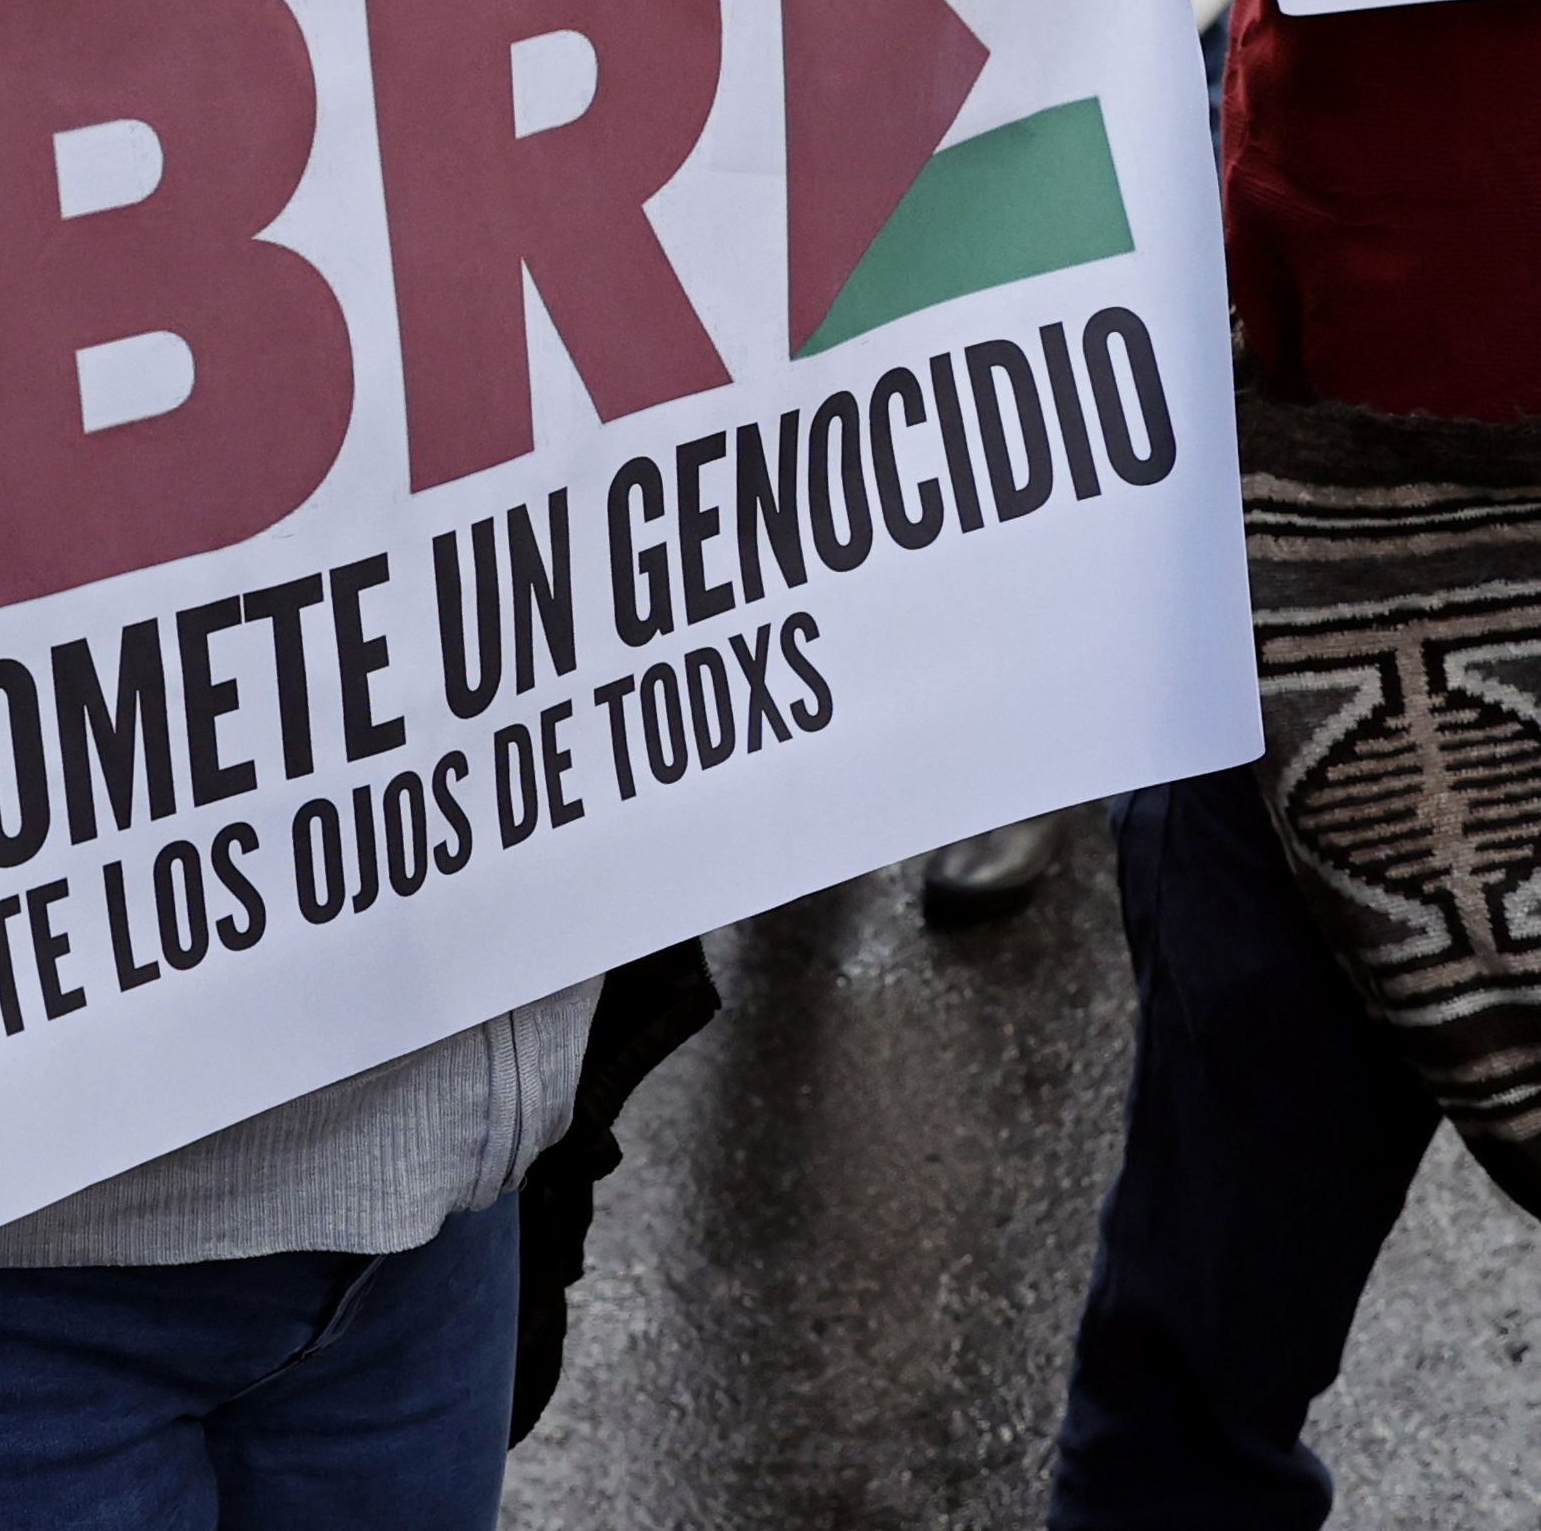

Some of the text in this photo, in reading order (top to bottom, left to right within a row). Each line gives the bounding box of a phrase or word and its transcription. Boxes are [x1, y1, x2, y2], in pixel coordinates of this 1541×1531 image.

[431, 486, 578, 720] UN
[607, 305, 1178, 648] GENOCIDIO
[102, 820, 266, 993] LOS
[290, 748, 473, 925] OJOS
[493, 698, 586, 851] DE
[593, 610, 835, 802] TODXS
